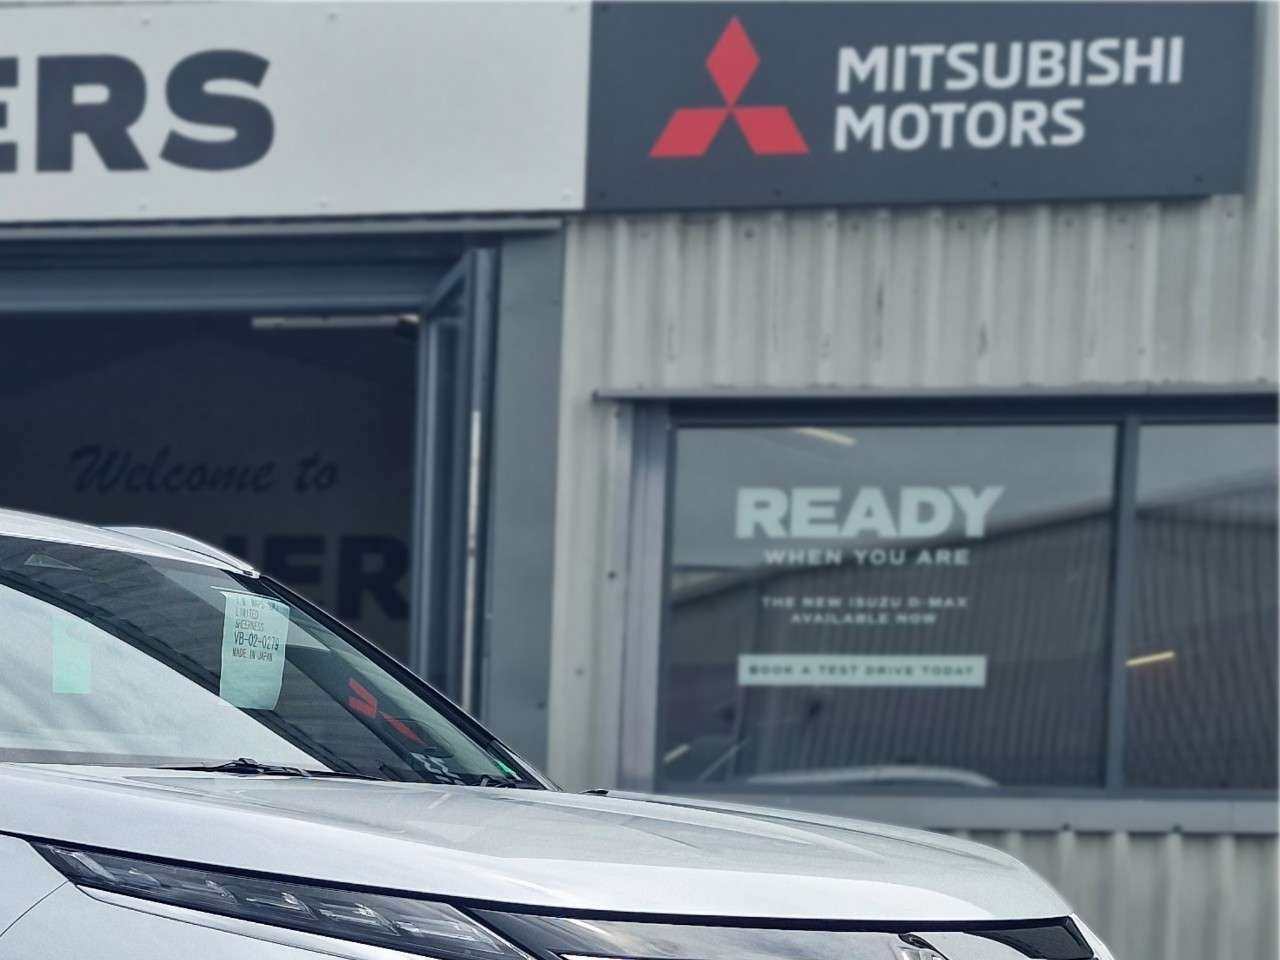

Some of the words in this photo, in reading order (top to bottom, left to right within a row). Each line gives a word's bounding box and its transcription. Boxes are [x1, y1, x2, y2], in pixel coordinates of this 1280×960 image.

[836, 37, 1184, 94] MITSUBISHI
[833, 98, 1086, 152] MOTORS
[70, 445, 275, 493] Welcome
[295, 452, 339, 492] to
[735, 486, 1006, 539] READY
[764, 549, 842, 566] WHEN
[855, 548, 906, 566] YOU
[916, 548, 971, 566] ARE
[762, 596, 795, 608] THE
[801, 596, 842, 608] NEW
[849, 596, 901, 608] ISUZU
[907, 596, 969, 608] D-MAX
[790, 613, 889, 625] AVAILABLE
[895, 613, 937, 625] NOW
[749, 665, 793, 676] BOOK
[801, 665, 812, 676] A
[819, 665, 858, 676] TEST
[865, 665, 914, 677] DRIVE
[922, 665, 975, 677] TODAY
